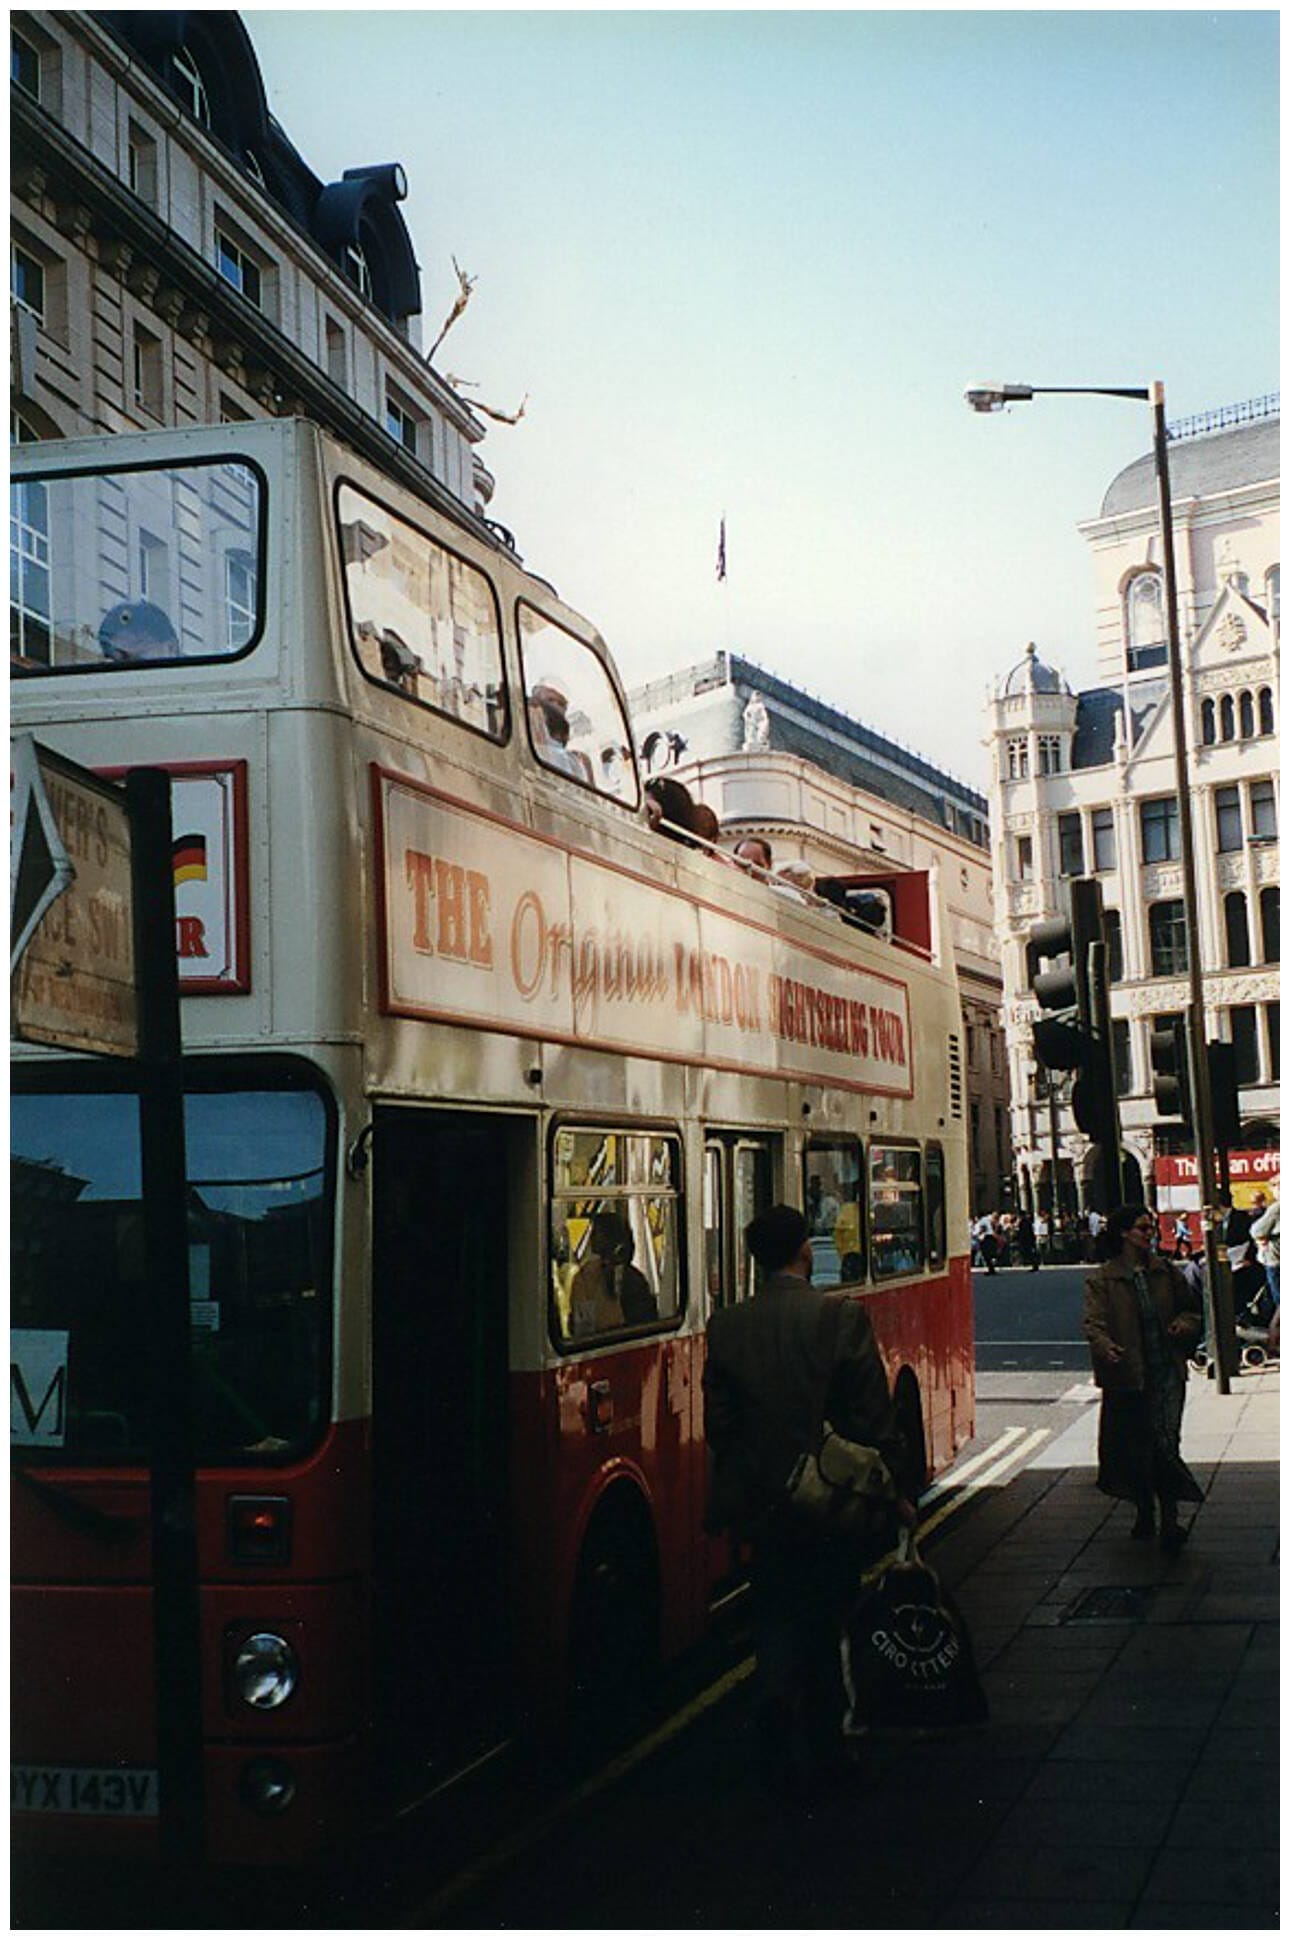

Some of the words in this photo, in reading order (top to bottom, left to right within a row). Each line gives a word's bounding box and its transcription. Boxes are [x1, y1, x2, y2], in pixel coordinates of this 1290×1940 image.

[404, 849, 494, 972] THE
[868, 1005, 906, 1067] TOUR
[1229, 1158, 1250, 1174] an
[1252, 1152, 1281, 1173] off
[871, 1629, 908, 1668] CIRO
